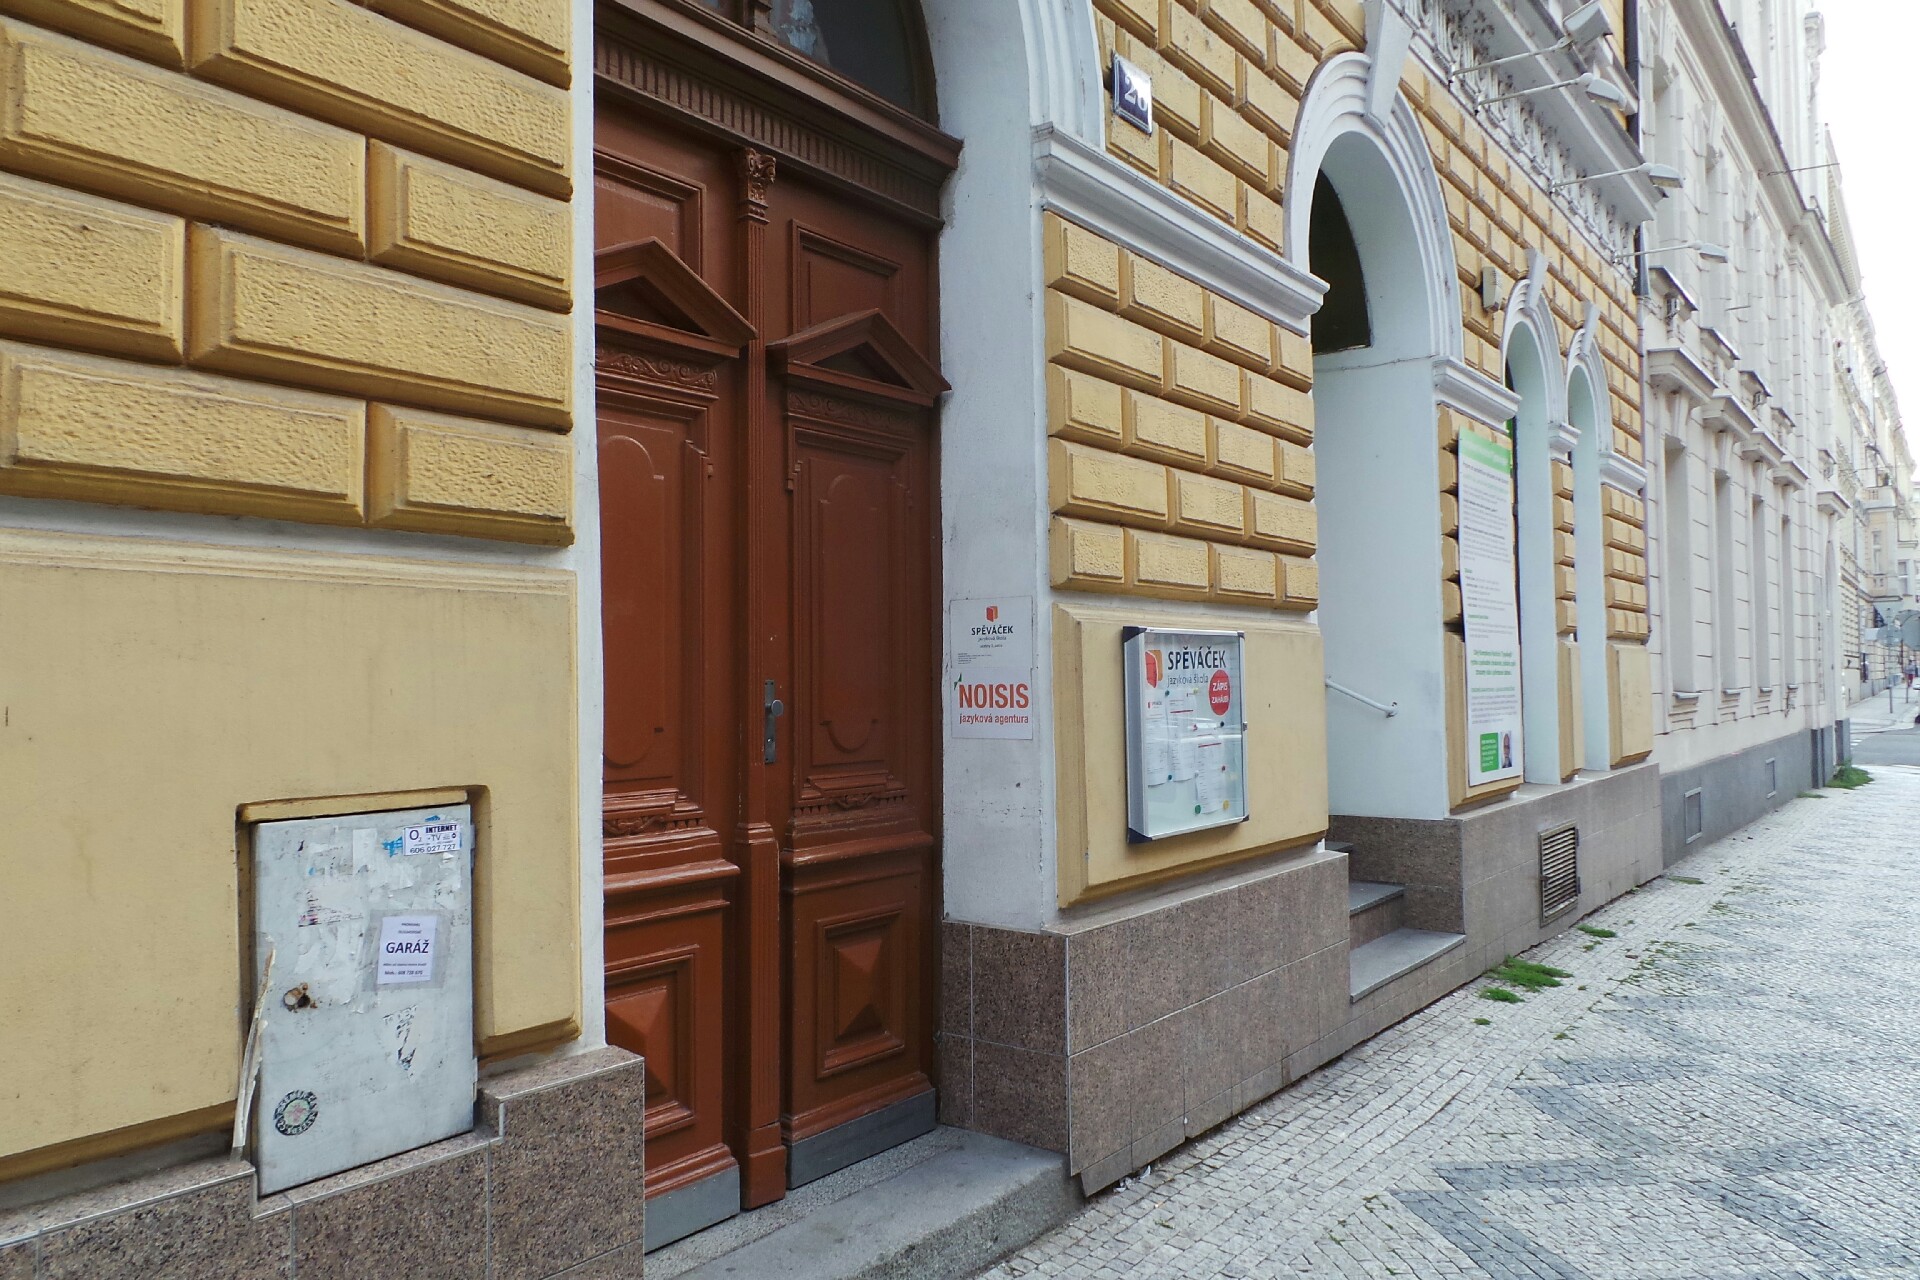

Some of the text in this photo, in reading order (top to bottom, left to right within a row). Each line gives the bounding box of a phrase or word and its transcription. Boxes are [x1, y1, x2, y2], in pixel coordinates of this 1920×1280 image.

[971, 625, 1014, 636] SPĚVÁČEK
[1167, 646, 1227, 671] SPĚVÁČEK
[1167, 673, 1208, 688] jazyková škola
[958, 683, 1029, 709] NOISIS
[959, 713, 1029, 725] jazyková agentura
[385, 938, 430, 954] GARÁŽ
